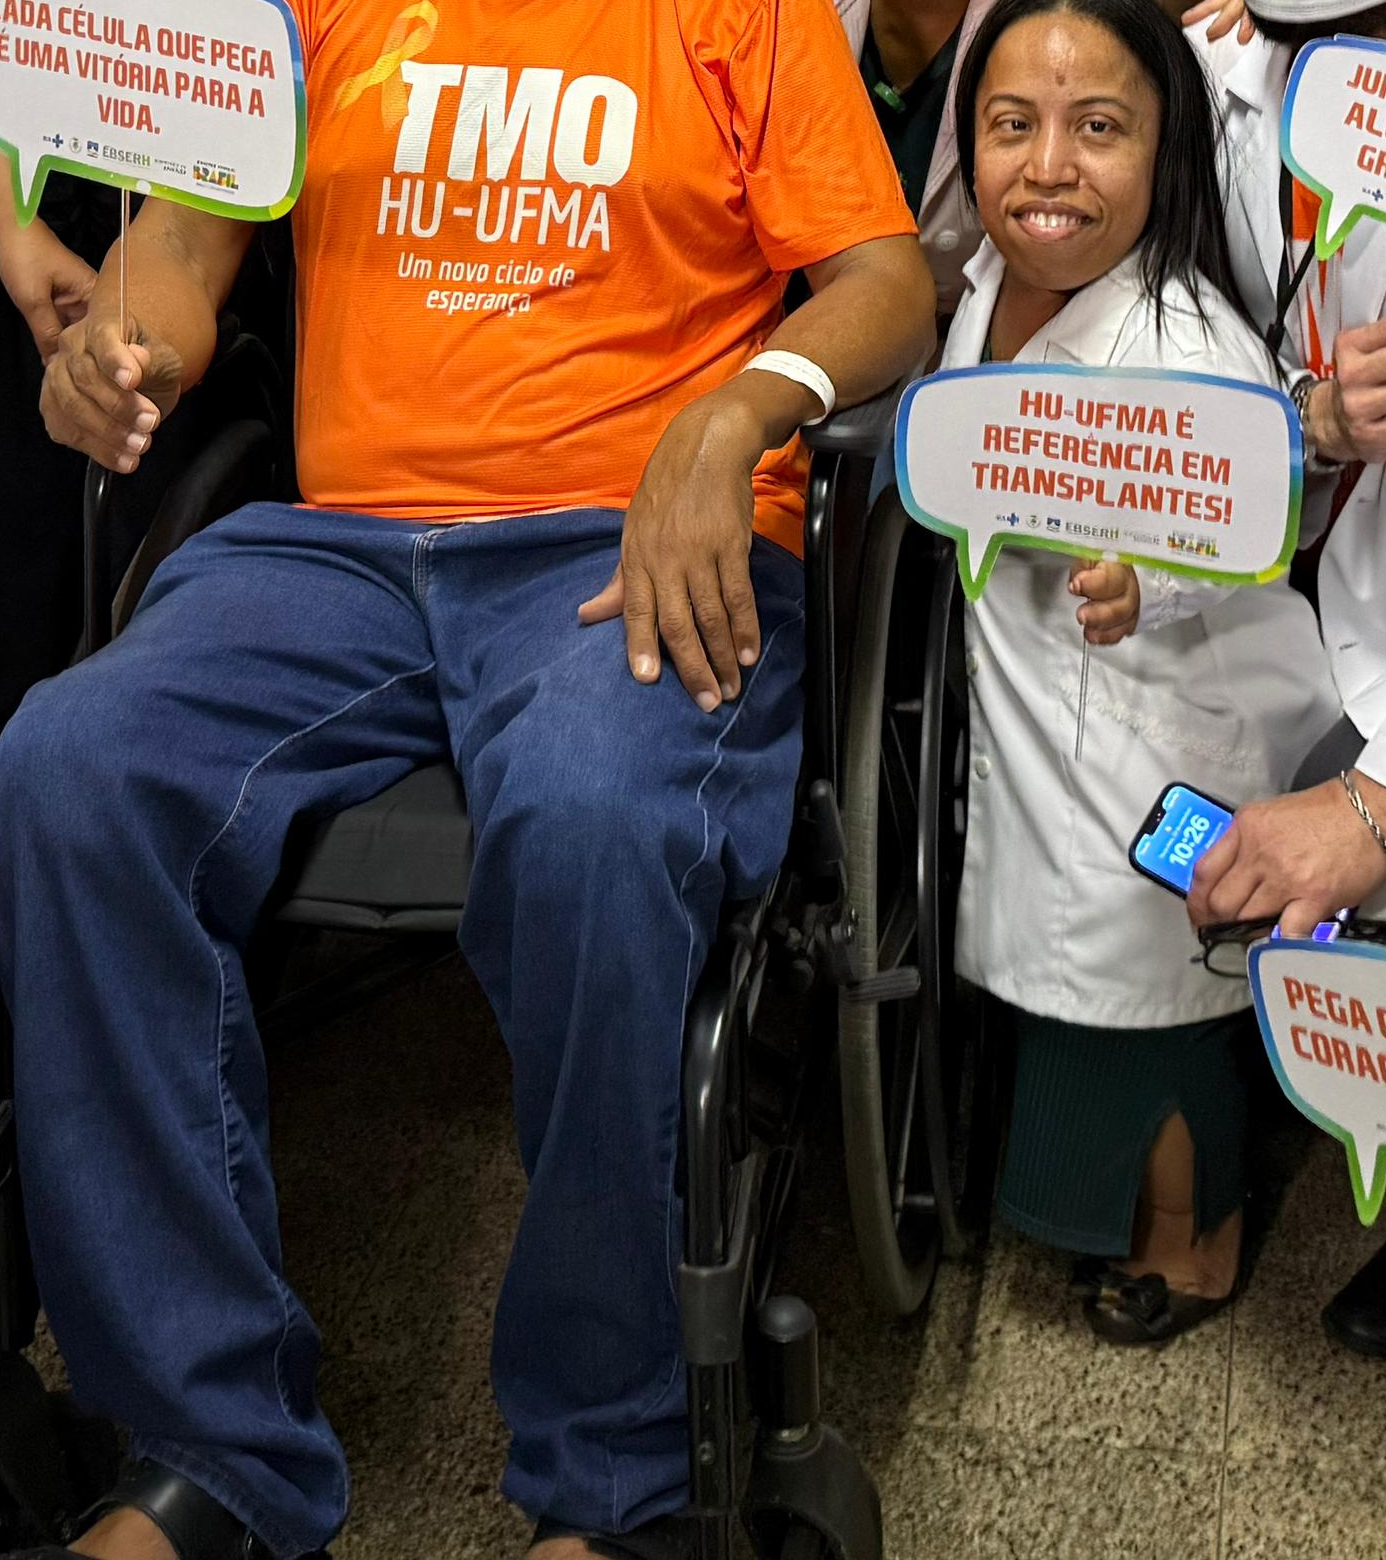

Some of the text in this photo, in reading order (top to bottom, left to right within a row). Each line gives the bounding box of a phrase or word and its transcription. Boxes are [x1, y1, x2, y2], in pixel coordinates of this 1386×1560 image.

[58, 3, 151, 53] CÉLULA
[157, 27, 205, 64] QUE
[211, 38, 276, 80] PEGA
[15, 37, 69, 75] UMA
[76, 51, 169, 96] VITÓRIA
[175, 71, 243, 113] PARA
[248, 87, 265, 118] A
[97, 94, 161, 134] VIDA.
[393, 60, 638, 189] TMO
[102, 145, 152, 167] EBSERH
[376, 176, 610, 252] HU-UFMA
[398, 252, 576, 288] Um novo ciclo de
[426, 287, 531, 317] esperança
[1019, 388, 1195, 439] HU-UFMA É
[983, 424, 1231, 486] REFERÊNCIA EM
[971, 461, 1233, 525] TRANSPLANTES!
[1169, 814, 1210, 866] 10:26
[1283, 976, 1373, 1036] PEGA
